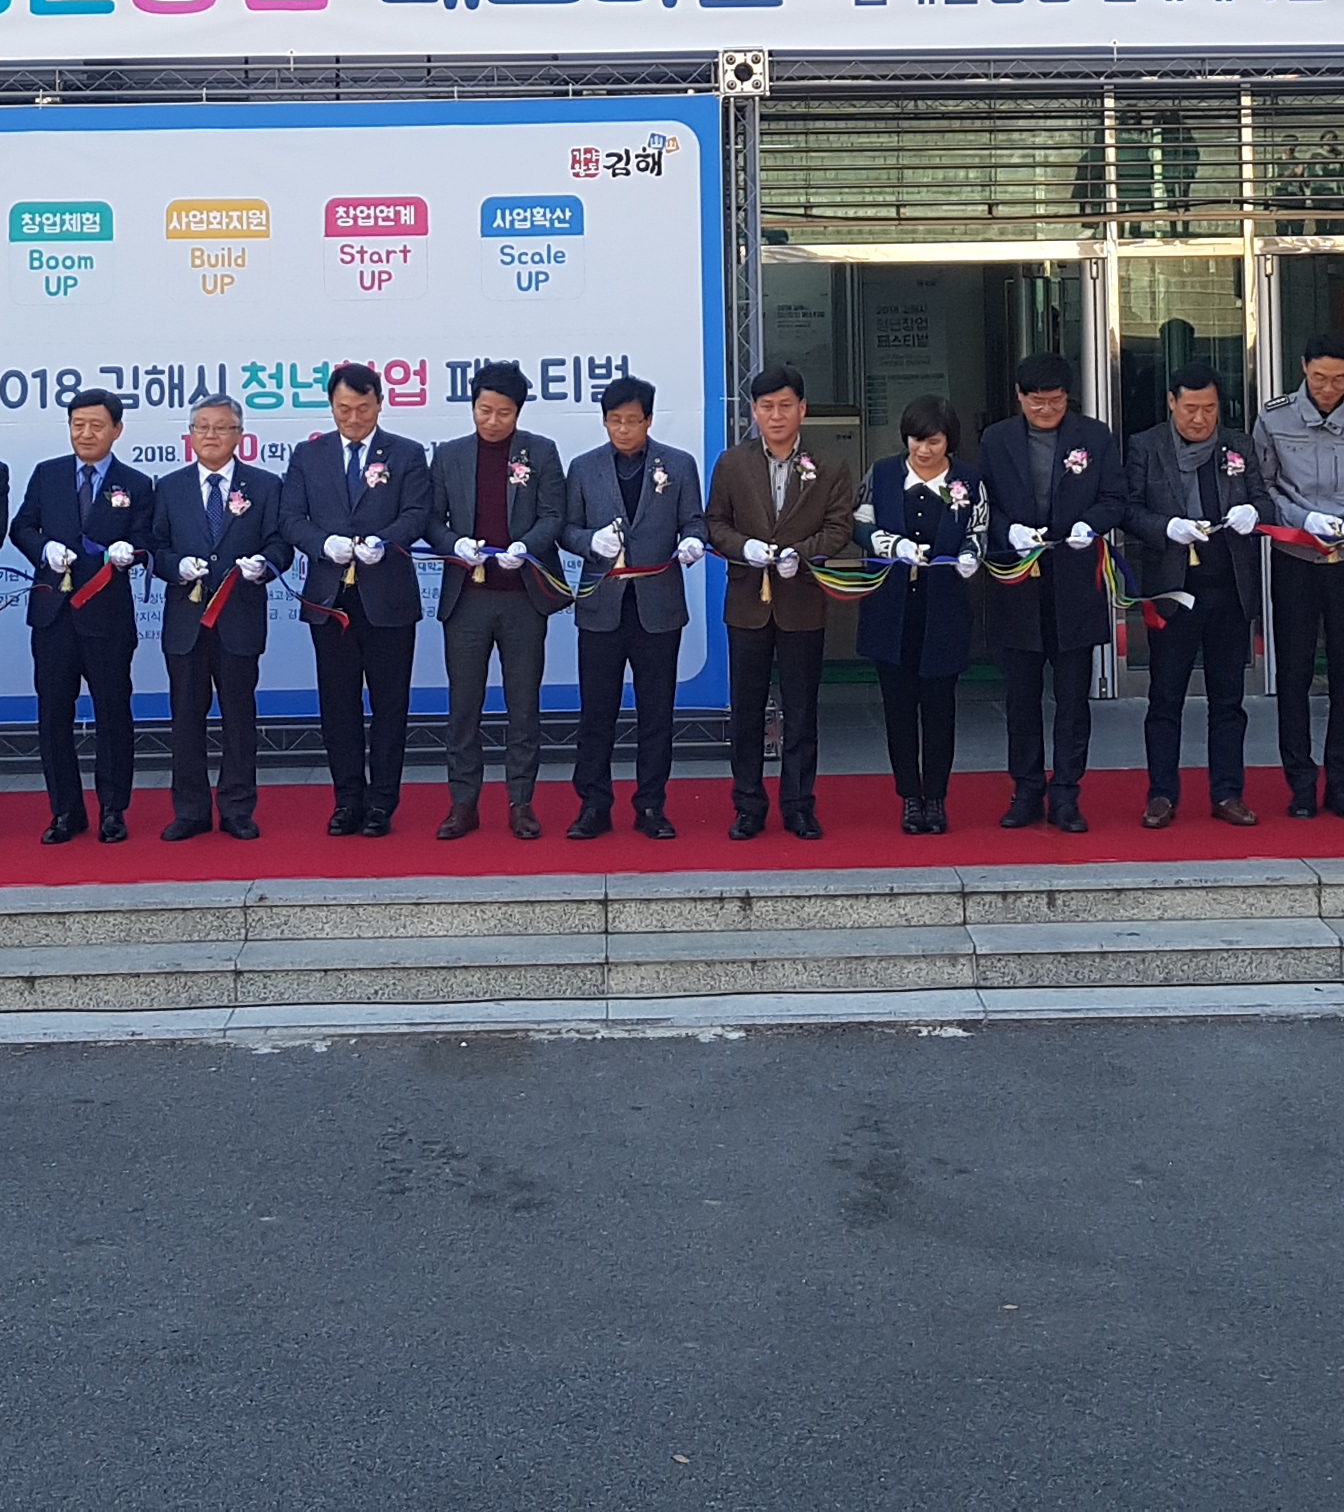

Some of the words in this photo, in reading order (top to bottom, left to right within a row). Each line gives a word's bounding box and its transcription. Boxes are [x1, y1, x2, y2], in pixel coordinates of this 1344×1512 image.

[603, 146, 663, 178] 김해
[20, 211, 101, 235] 창업체험
[169, 209, 267, 234] 사업화지원
[335, 205, 416, 229] 창업연계
[491, 206, 572, 230] 사업확산
[28, 250, 94, 272] Boom
[190, 246, 246, 270] Build
[339, 243, 411, 266] Start
[500, 243, 567, 266] Scale
[45, 275, 77, 296] UP
[201, 273, 235, 295] UP
[358, 269, 392, 291] UP
[517, 269, 549, 292] UP
[241, 361, 428, 410] 청년업
